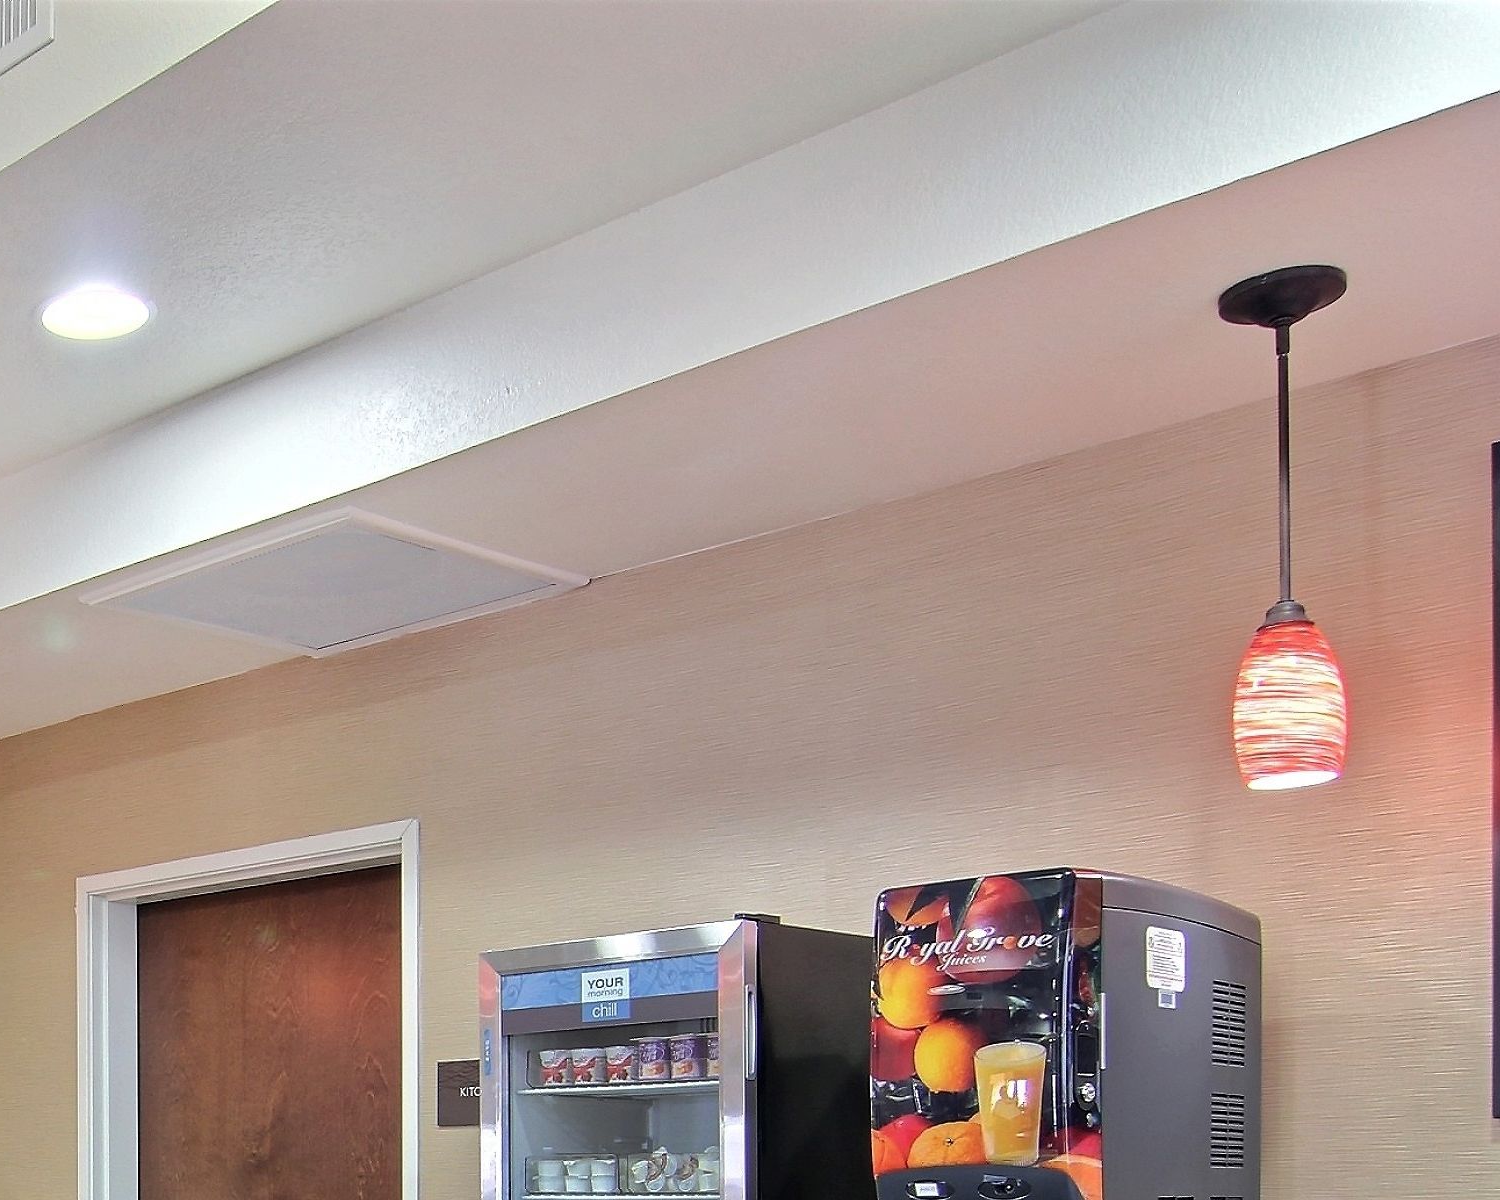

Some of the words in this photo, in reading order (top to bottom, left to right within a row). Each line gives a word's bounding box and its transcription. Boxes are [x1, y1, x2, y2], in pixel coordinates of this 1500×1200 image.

[880, 929, 966, 966] Royal
[967, 927, 1057, 952] Grove
[936, 952, 988, 972] Juices
[587, 977, 624, 989] YOUR
[587, 989, 623, 997] morning
[592, 1002, 618, 1018] chill
